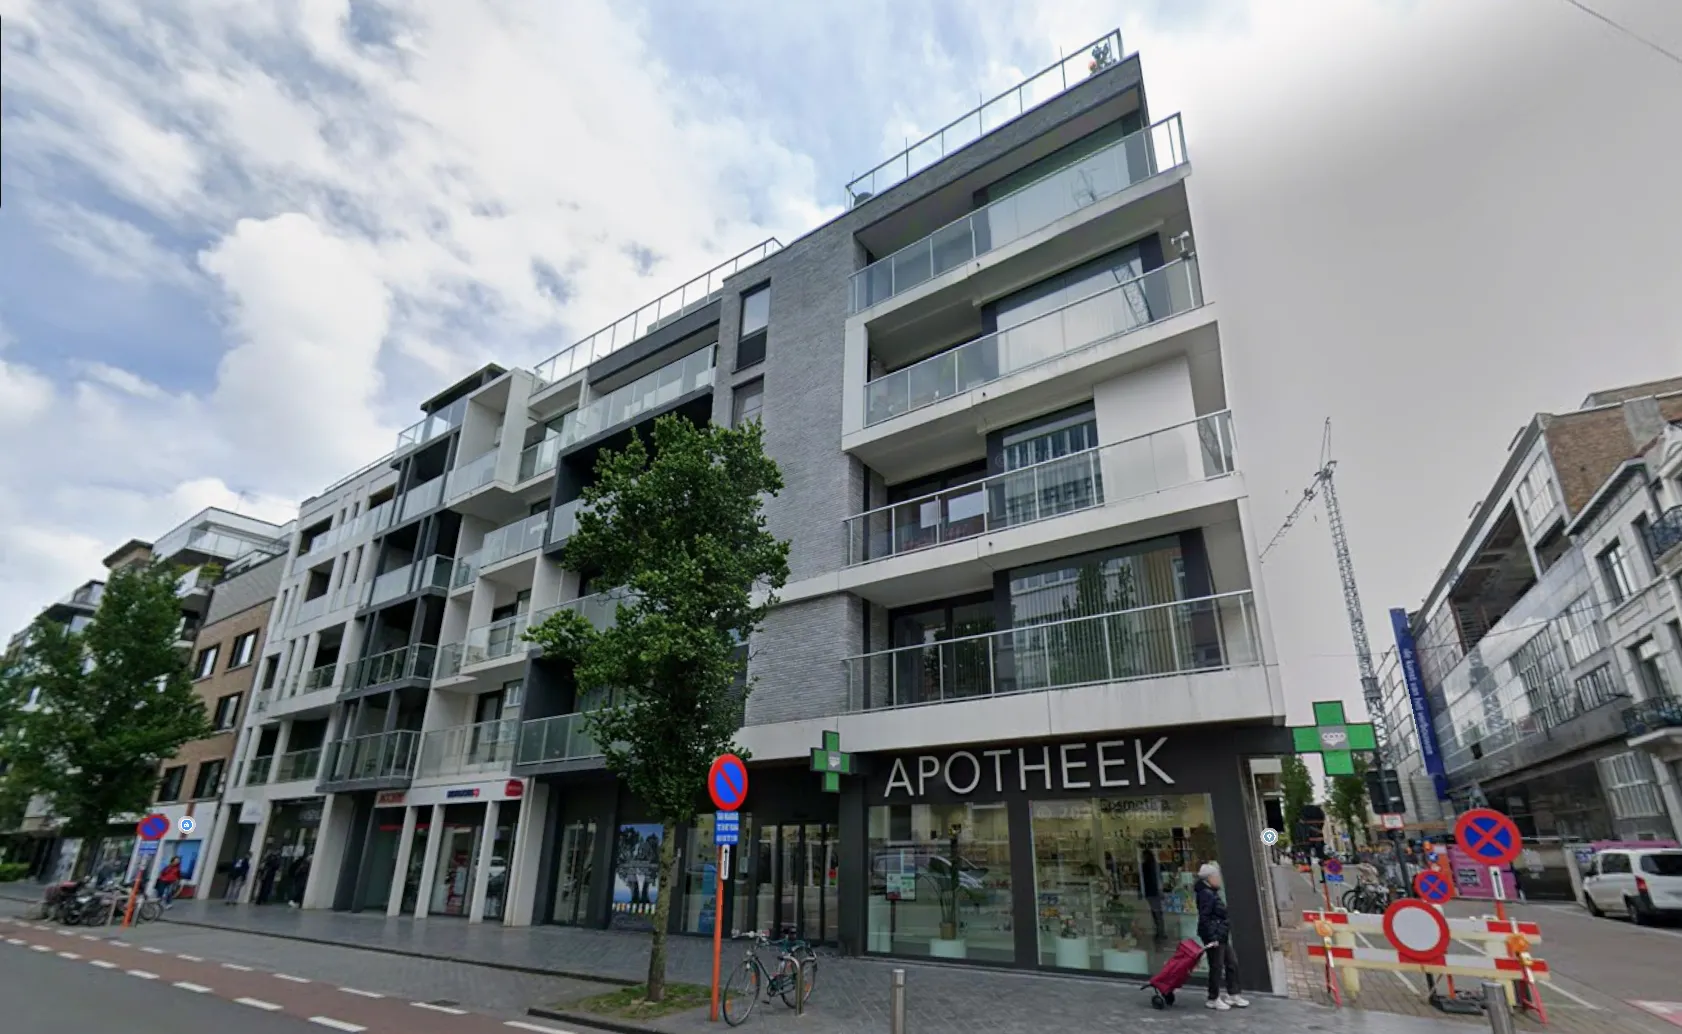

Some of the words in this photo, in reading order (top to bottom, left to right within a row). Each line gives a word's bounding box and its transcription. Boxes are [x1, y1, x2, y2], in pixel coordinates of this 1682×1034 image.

[1403, 648, 1413, 660] de
[1406, 659, 1418, 682] kunst
[1410, 682, 1420, 697] van
[1414, 697, 1425, 711] het
[1416, 712, 1434, 756] verbouwen
[884, 737, 1176, 798] APOTHEEK
